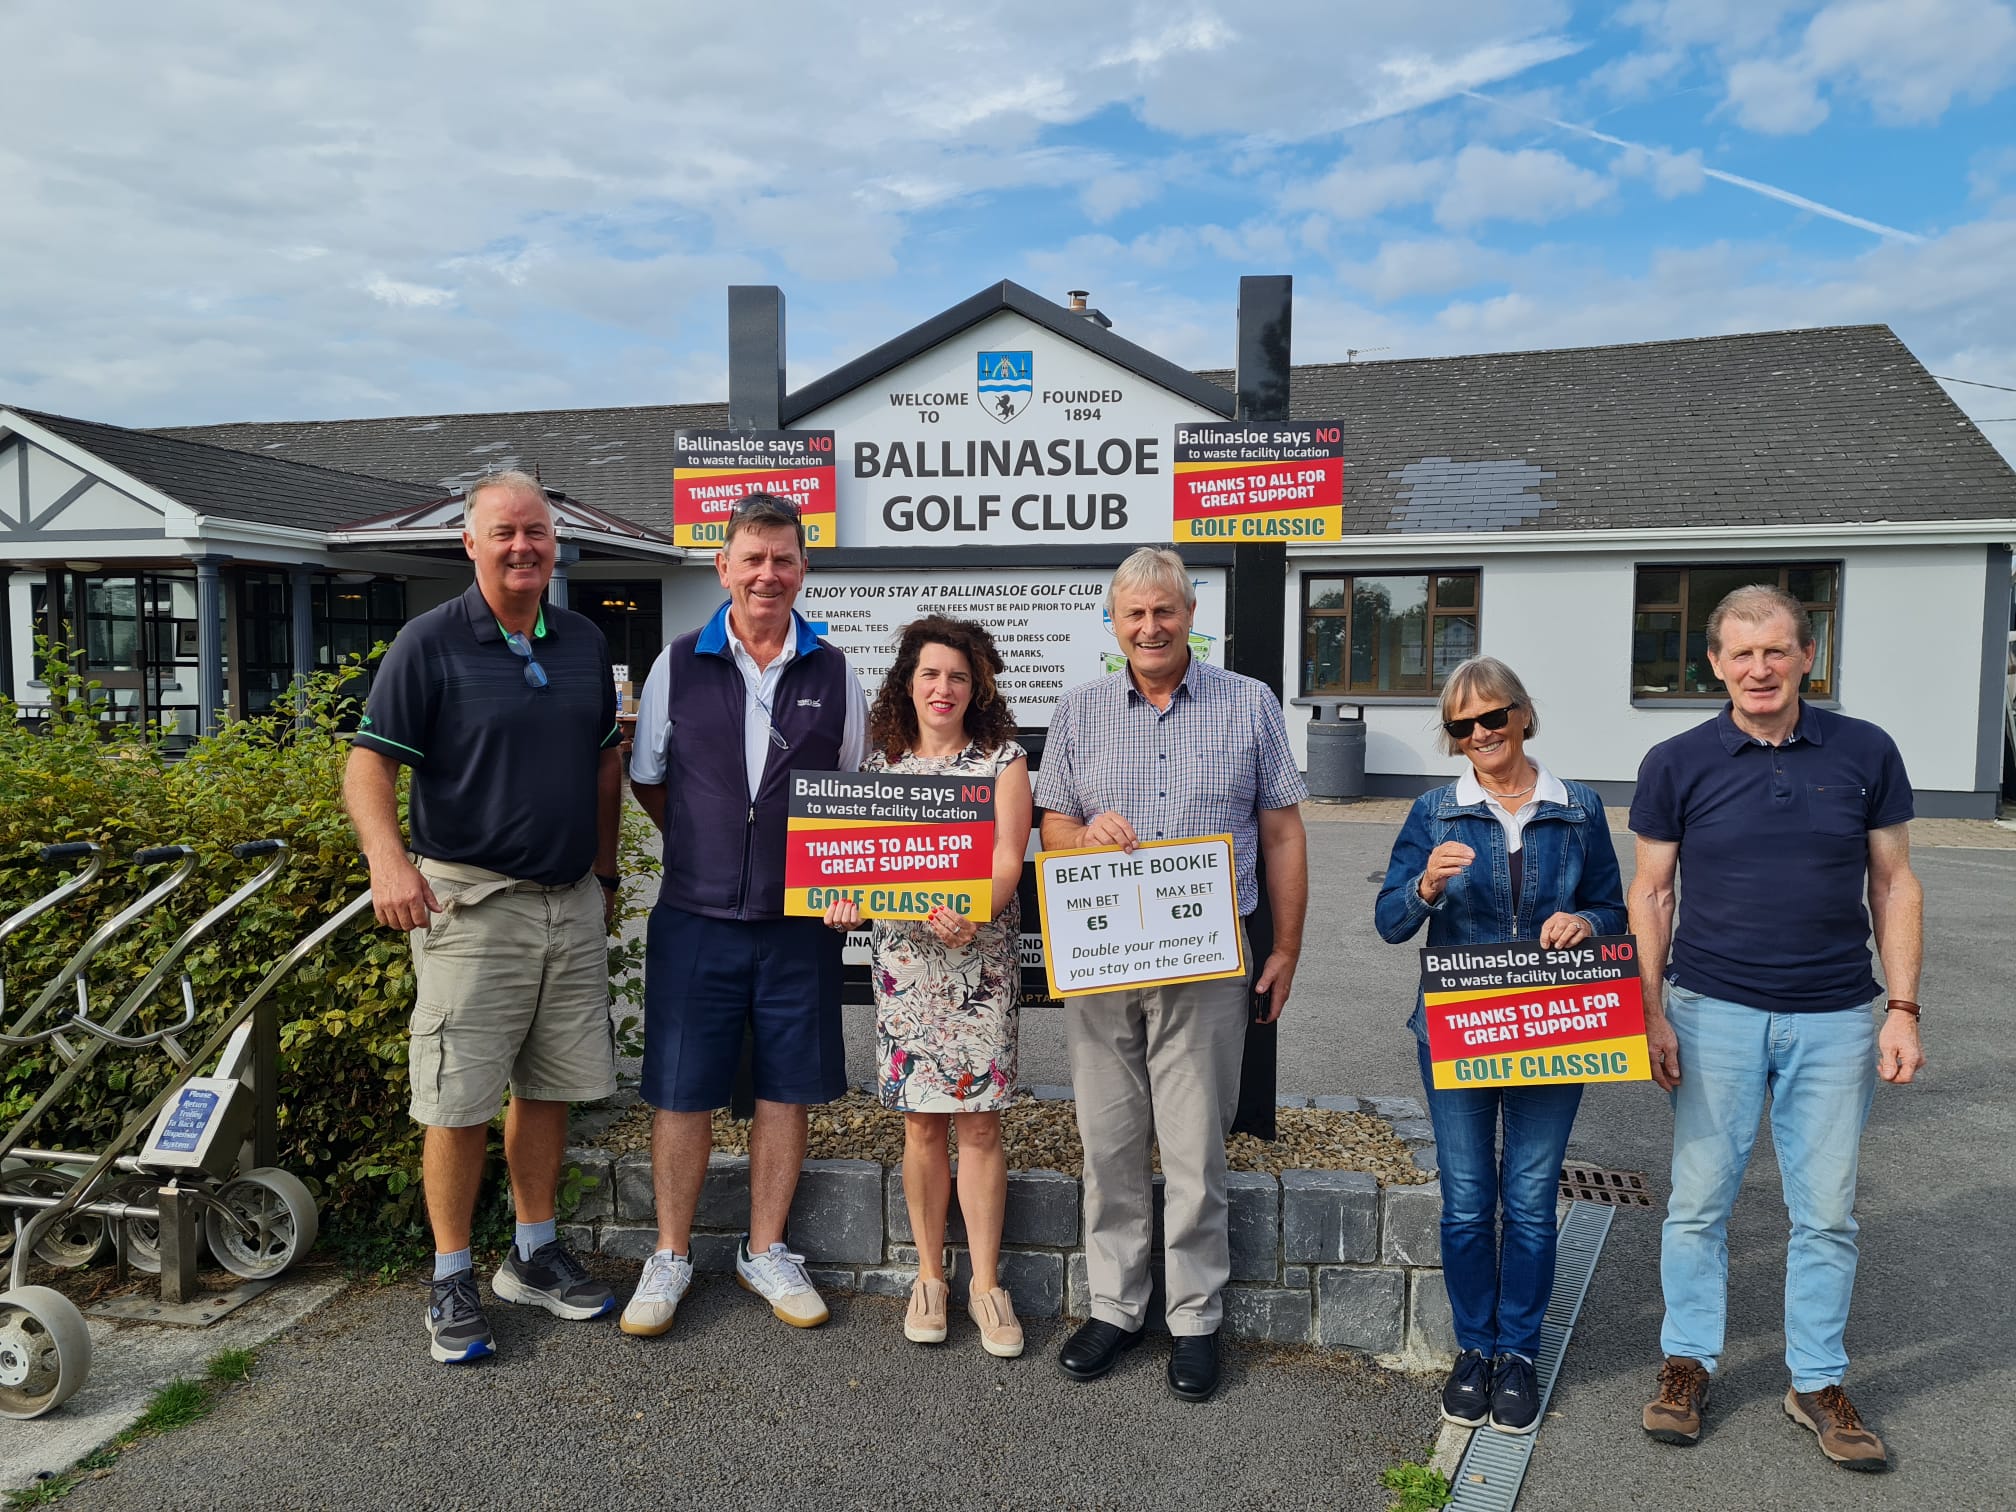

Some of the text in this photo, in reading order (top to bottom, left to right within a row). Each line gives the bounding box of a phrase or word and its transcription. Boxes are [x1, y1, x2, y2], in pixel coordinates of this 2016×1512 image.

[890, 393, 968, 406] WELCOME
[1043, 390, 1122, 404] FOUNDED
[919, 411, 940, 423] TO
[1065, 408, 1101, 421] 1894
[678, 436, 832, 455] Ballinasloe says NO
[1179, 428, 1341, 447] Ballinasloe says NO
[854, 438, 1159, 478] BALLINASLOE
[1188, 446, 1330, 460] to waste facility location
[688, 455, 822, 468] to waste facility location
[688, 483, 742, 500] THANKS
[766, 480, 790, 493] ALL
[792, 478, 820, 490] FOR
[1188, 470, 1326, 494] THANKS TO ALL FOR
[1201, 486, 1315, 508] GREAT SUPPORT
[701, 498, 738, 513] GREA
[882, 494, 1128, 532] GOLF CLUB
[692, 524, 724, 541] GOL
[1191, 518, 1325, 536] GOLF CLASSIC
[805, 584, 1102, 598] ENJOY YOUR STAY AT BALLINASLOE GOLF CLUB
[806, 610, 872, 618] TEE MARKERS
[916, 602, 1096, 612] GREEN FEES MUST BE PAID PRIOR TO PLAY
[830, 624, 889, 632] MEDAL TEES
[980, 618, 1005, 626] SLOW
[1008, 618, 1028, 626] PLAY
[992, 634, 1071, 642] CLUB DRESS CODE
[838, 646, 896, 654] OCIETY TEES
[1010, 650, 1044, 658] MARKS,
[1014, 680, 1027, 688] OR
[1029, 680, 1063, 688] GREENS
[1018, 696, 1060, 704] MEASURE
[795, 778, 991, 806] Ballinasloe says NO
[807, 802, 977, 820] to waste facility location
[805, 835, 973, 857] THANKS TO ALL FOR
[820, 854, 960, 874] GREAT SUPPORT
[1056, 853, 1218, 884] BEAT THE BOOKIE
[1156, 882, 1214, 898] MAX BET
[870, 890, 971, 914] CLASSIC
[1067, 894, 1120, 910] MIN BET
[1171, 902, 1203, 920] €20
[1087, 915, 1108, 930] €5
[1072, 931, 1220, 959] Double your money if
[1426, 943, 1633, 973] Ballinasloe says NO
[1070, 952, 1225, 981] you stay on the Green.
[1441, 966, 1622, 988] to waste facility location
[1445, 992, 1620, 1030] THANKS TO ALL FOR
[1463, 1012, 1608, 1046] GREAT SUPPORT
[1455, 1052, 1628, 1081] GOLF CLASSIC
[189, 1090, 212, 1098] Please
[183, 1100, 208, 1108] Return
[179, 1110, 203, 1120] Trolley
[178, 1120, 194, 1128] Back
[162, 1140, 190, 1149] System
